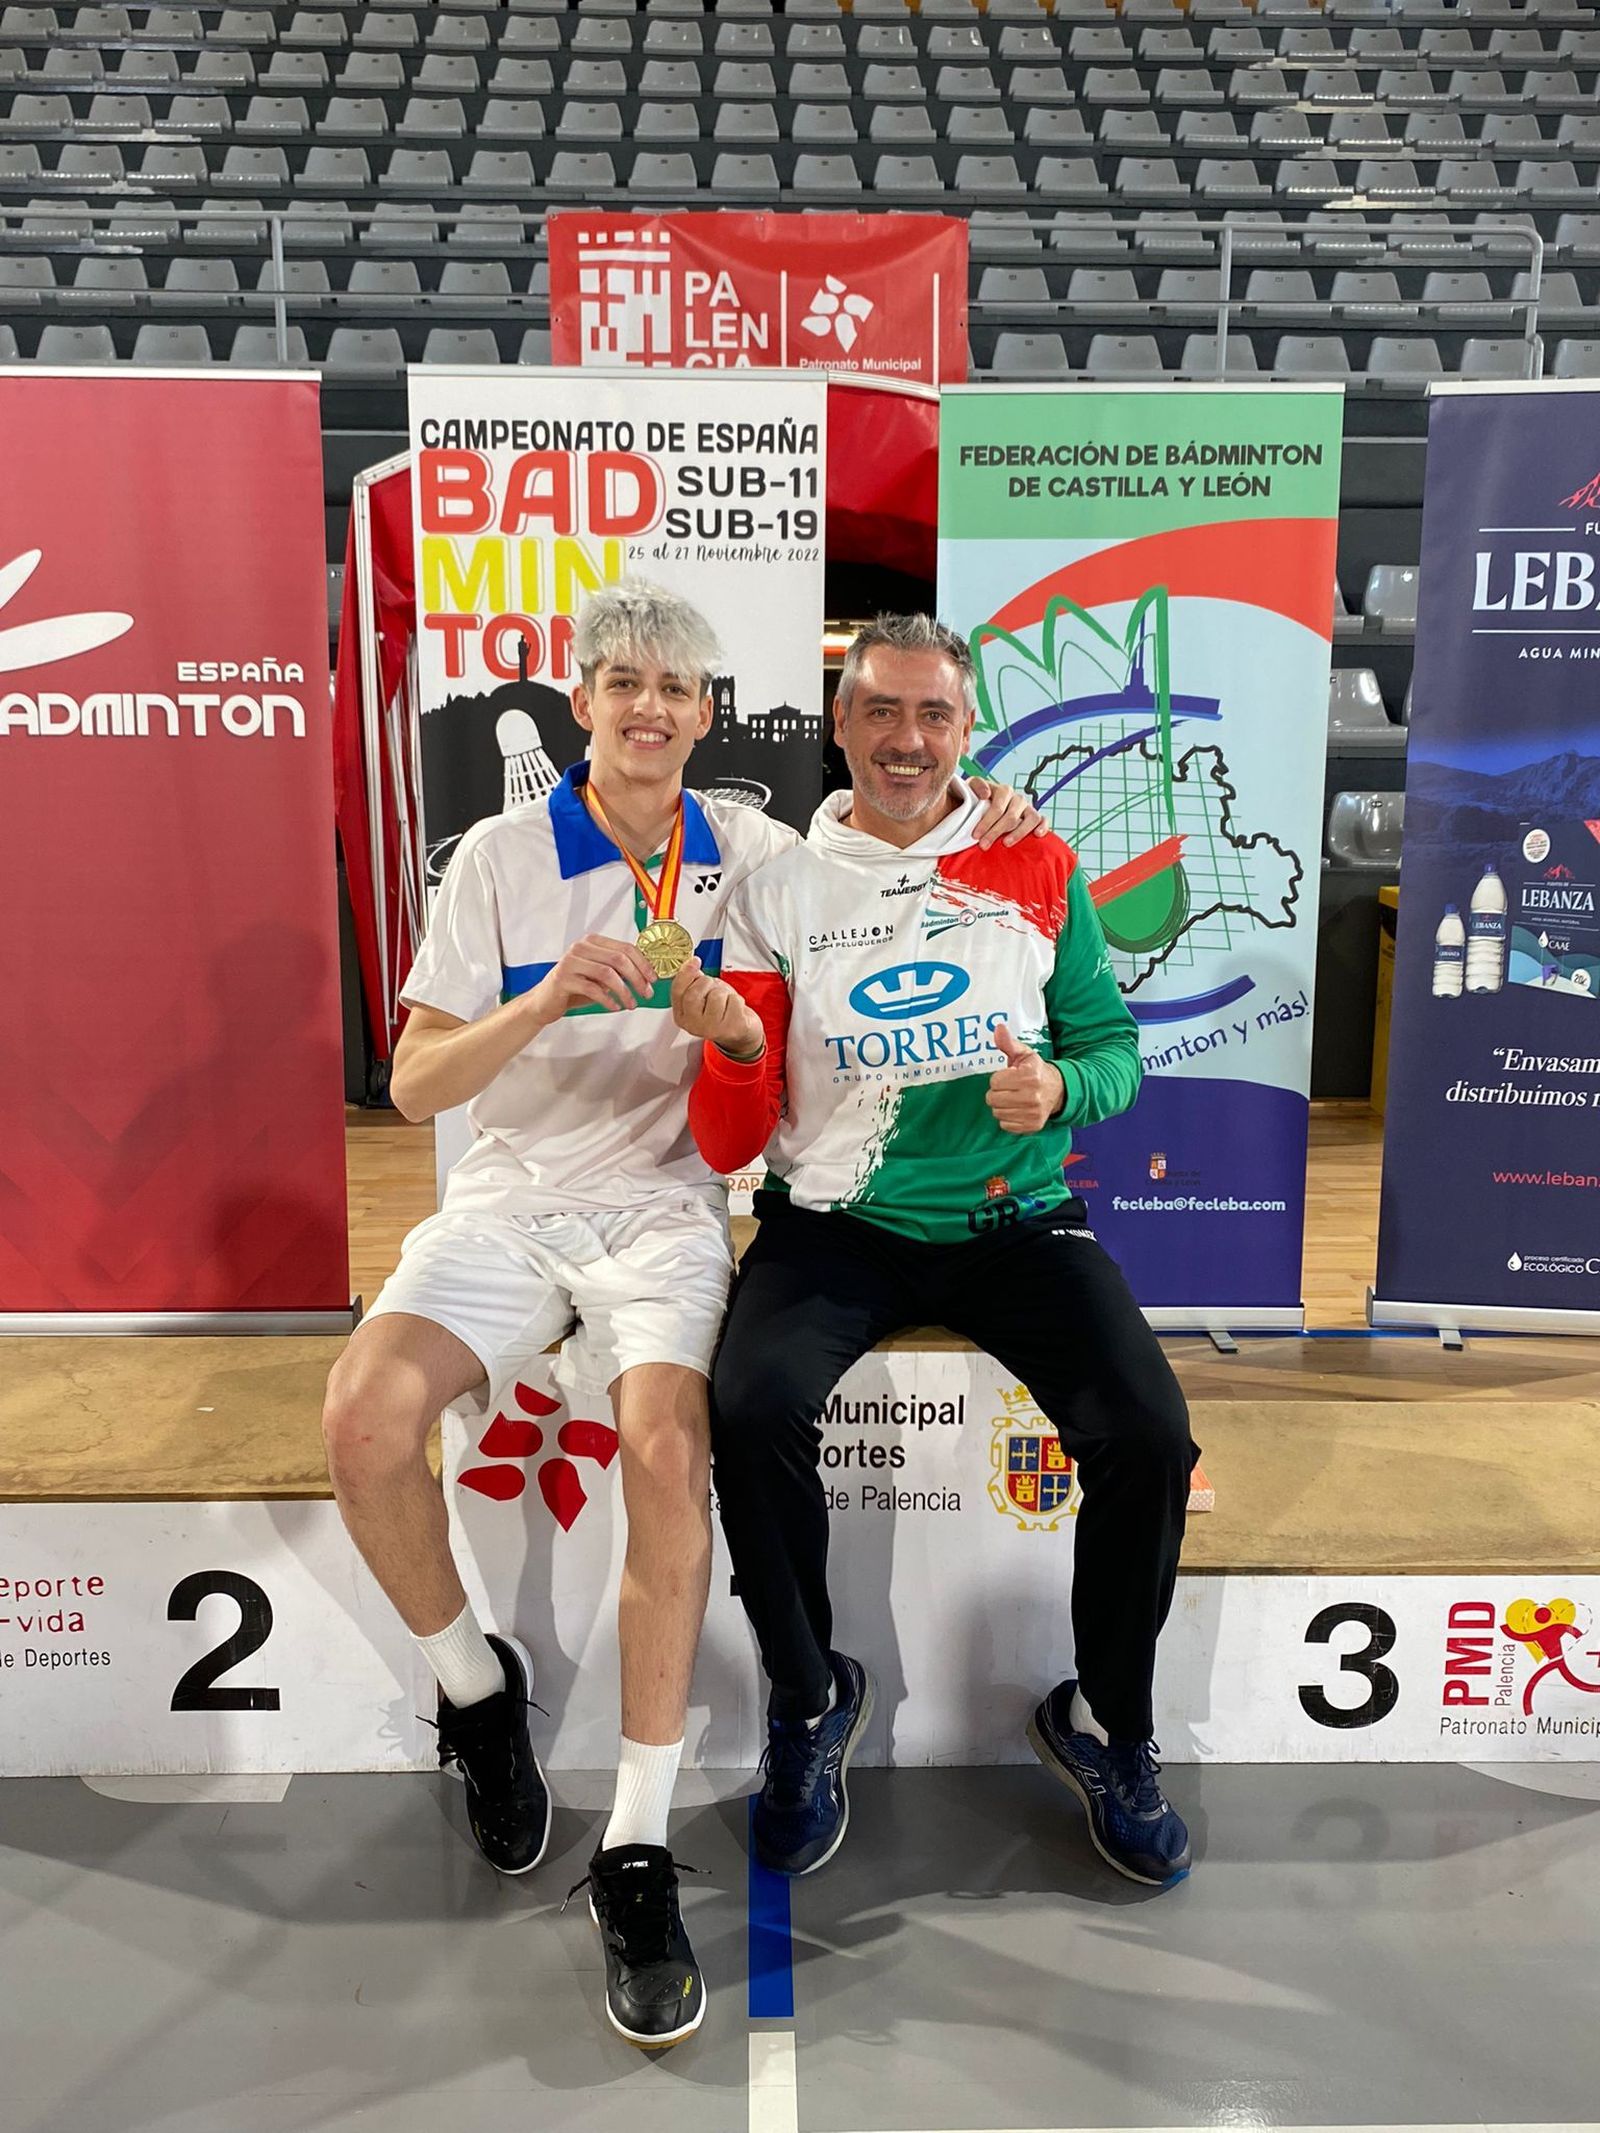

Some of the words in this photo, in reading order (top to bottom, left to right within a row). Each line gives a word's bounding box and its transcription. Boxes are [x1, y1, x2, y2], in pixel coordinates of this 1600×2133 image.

[685, 271, 741, 307] PA
[685, 313, 769, 349] LEN
[800, 358, 859, 370] Patronato
[863, 358, 922, 371] Municipal
[420, 419, 635, 452] CAMPEONATO
[647, 422, 686, 452] DE
[697, 416, 819, 454] ESPAÑA
[960, 441, 1120, 466] FEDERACIÓN
[1126, 445, 1158, 466] DE
[1165, 440, 1323, 466] BÁDMINTON
[419, 450, 666, 537] BAD
[677, 466, 819, 498] SUB-11
[1008, 476, 1041, 498] DE
[1048, 475, 1169, 498] CASTILLA
[1179, 476, 1197, 497] Y
[1203, 472, 1272, 497] LEÓN
[665, 508, 819, 541] SUB-19
[628, 546, 645, 561] 25
[652, 542, 670, 561] al
[675, 546, 689, 561] 27
[788, 547, 820, 562] 2022
[421, 536, 627, 615] MIN
[1472, 551, 1600, 611] LEB
[1518, 647, 1563, 660] AGUA
[177, 656, 304, 683] ESPAÑA
[1521, 888, 1595, 912] LEBANZA
[977, 909, 1010, 919] Granada
[1232, 1020, 1249, 1044] y
[1255, 990, 1312, 1030] más!
[824, 1012, 1010, 1071] TORRES
[832, 1073, 884, 1084] GRUPO
[1445, 1080, 1588, 1107] distribuimos
[1492, 1171, 1600, 1188] www.leban
[1112, 1196, 1287, 1212] fecleba@fecleba.com
[1523, 1262, 1585, 1274] ECOLÓGICO
[816, 1394, 965, 1431] Municipal
[861, 1485, 962, 1512] Palencia
[166, 1570, 281, 1712] 2
[1442, 1601, 1497, 1706] PMD
[25, 1648, 112, 1671] Deportes
[1297, 1602, 1400, 1729] 3
[1494, 1643, 1517, 1707] Palencia
[1440, 1716, 1528, 1736] Patronato
